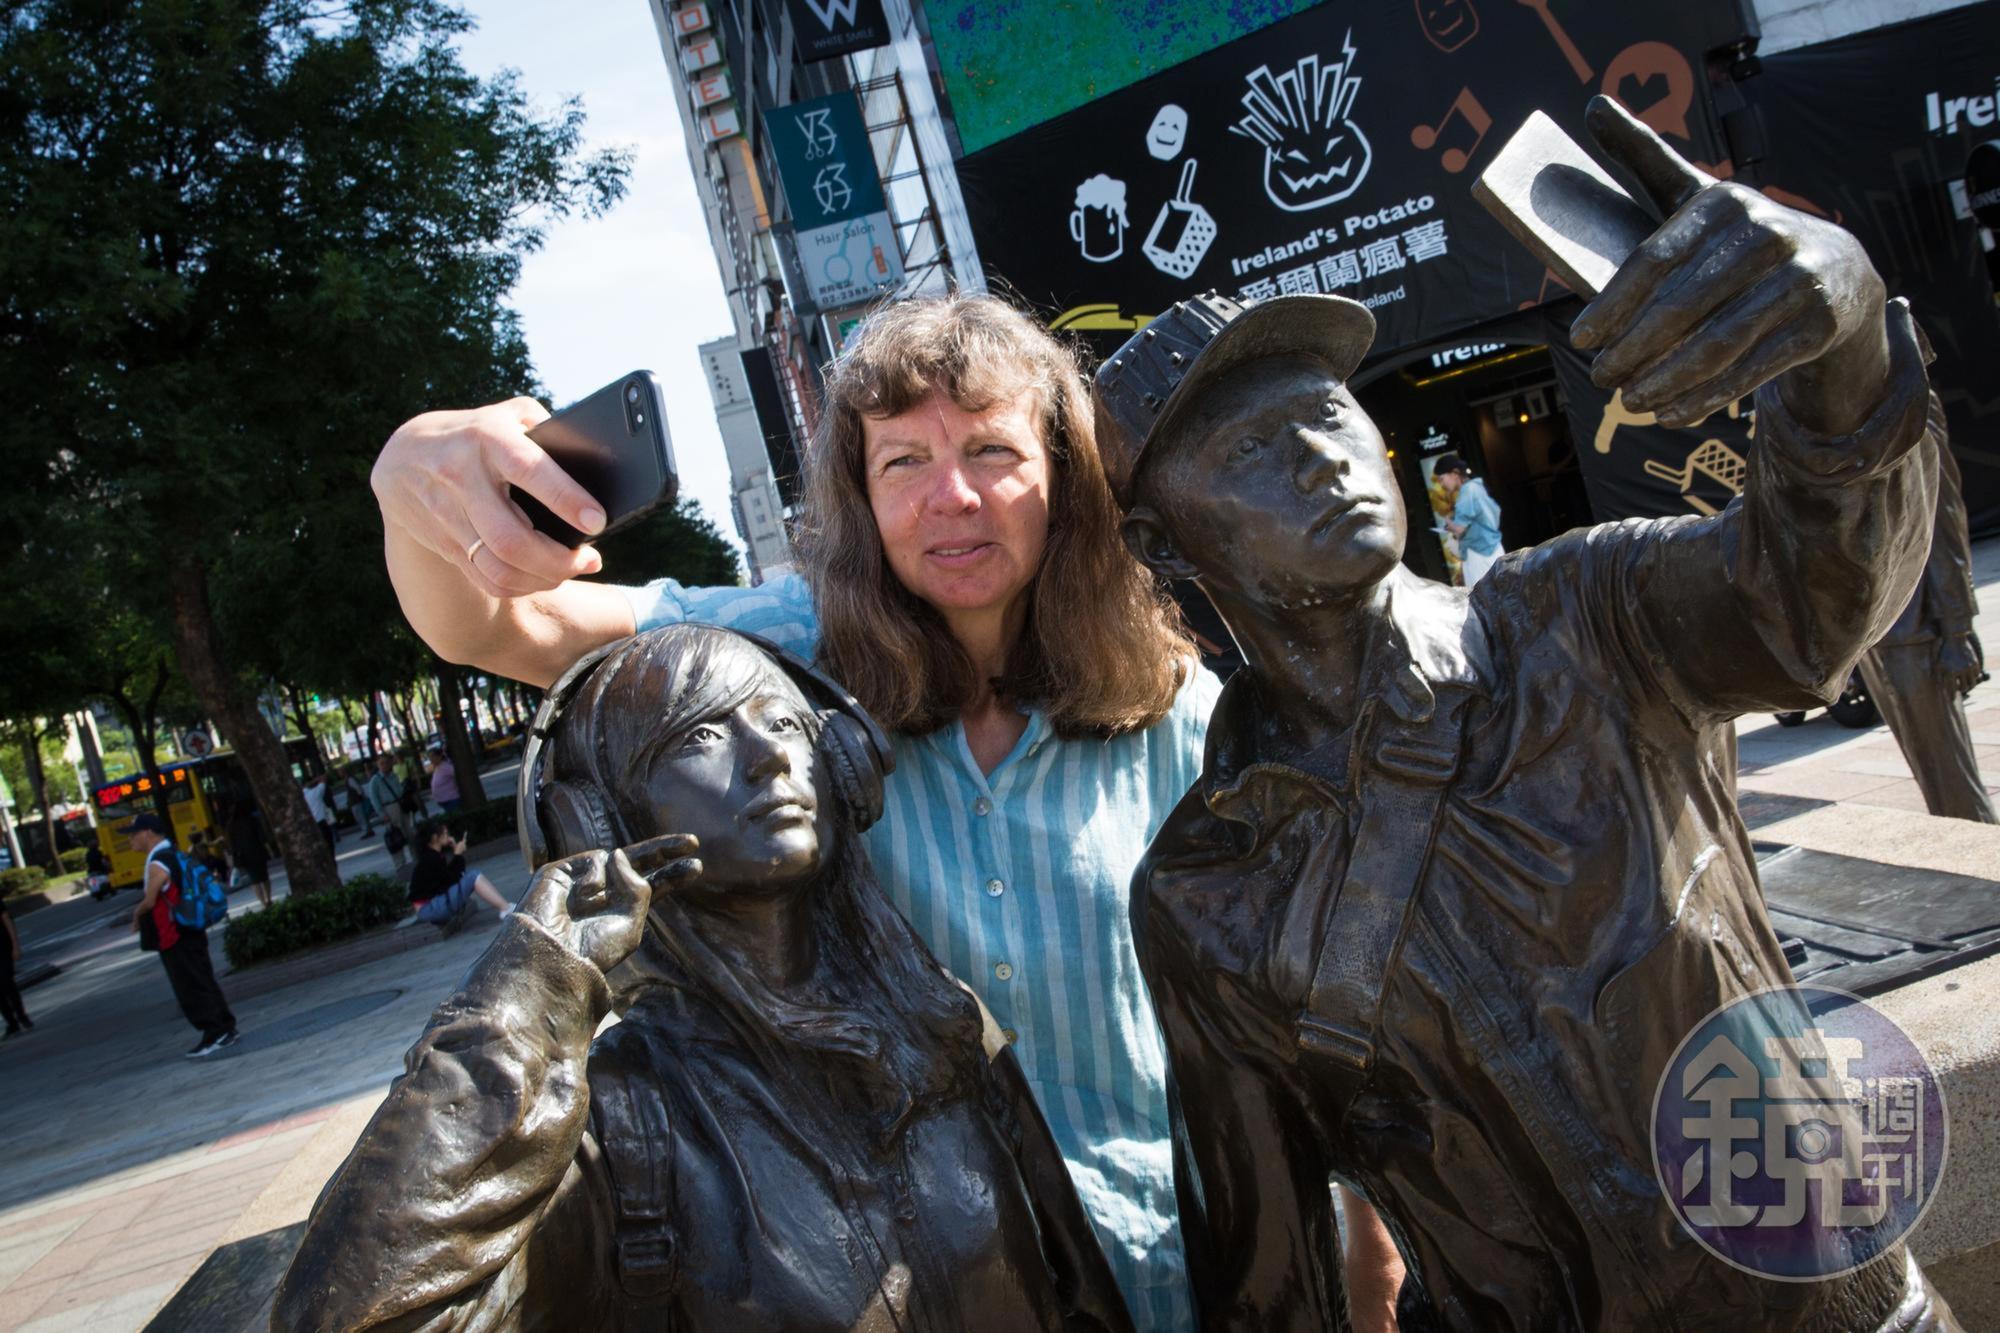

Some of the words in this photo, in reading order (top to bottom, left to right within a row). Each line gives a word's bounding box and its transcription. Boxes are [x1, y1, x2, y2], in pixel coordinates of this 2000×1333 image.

[813, 34, 844, 49] WHITE
[815, 232, 842, 247] Hair
[843, 224, 876, 239] Salon
[1231, 227, 1339, 276] Ireland's
[1343, 194, 1435, 237] Potato
[1238, 218, 1449, 306] 愛爾蘭瘋薯
[1356, 285, 1406, 310] reland
[1431, 342, 1507, 368] Irela
